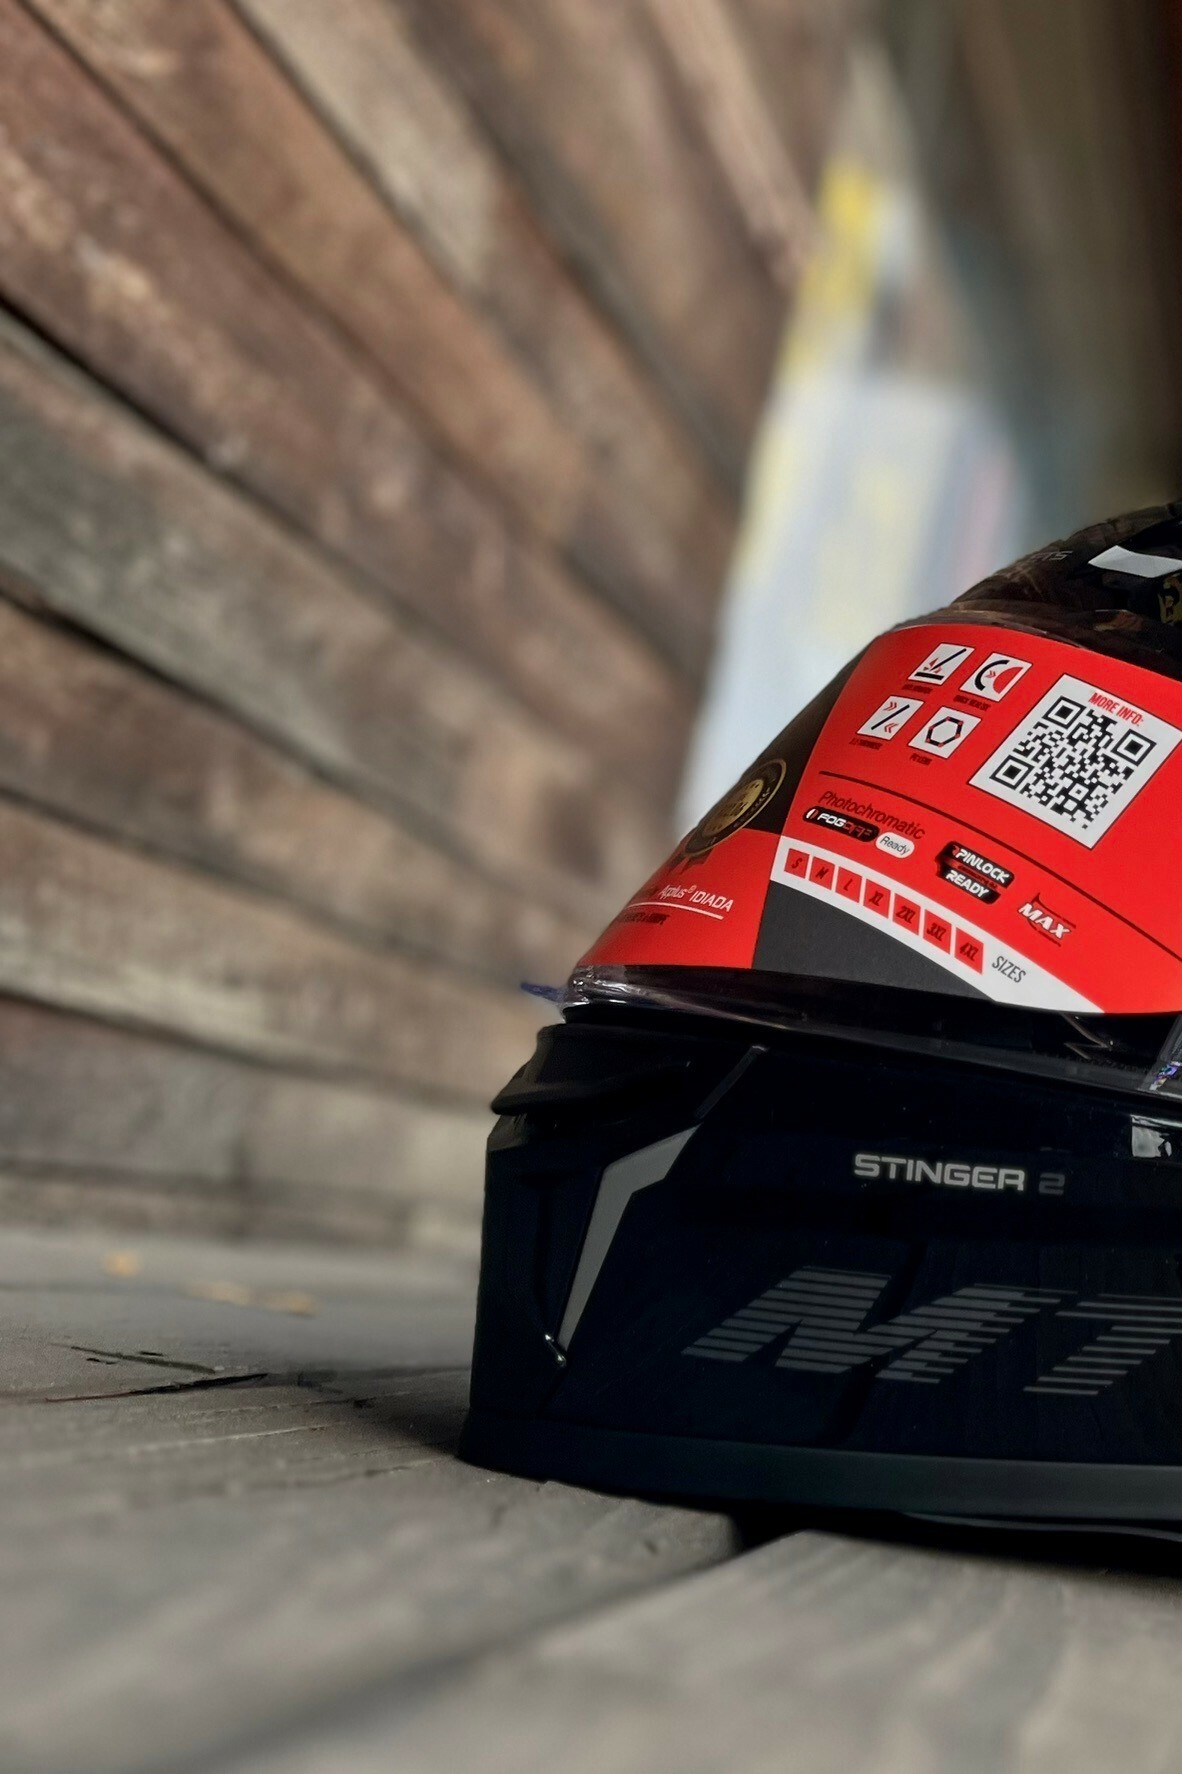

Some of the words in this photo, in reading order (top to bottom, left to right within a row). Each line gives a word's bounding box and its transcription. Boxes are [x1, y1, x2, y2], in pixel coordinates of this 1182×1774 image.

[1088, 692, 1119, 714] MORE
[1116, 706, 1143, 727] INFO:
[817, 790, 925, 840] Photochromatic
[879, 836, 909, 855] Ready
[945, 869, 989, 898] READY
[955, 848, 1010, 884] PINLOCK
[689, 890, 734, 913] IDIADA
[791, 857, 803, 869] S
[815, 866, 829, 880] M
[843, 878, 853, 892] L
[896, 905, 916, 924] 2XL
[926, 922, 947, 942] 3XL
[959, 942, 979, 962] 4XL
[991, 955, 1027, 984] SIZES
[1017, 902, 1072, 939] MAX
[854, 1153, 1026, 1191] STINGER
[1038, 1172, 1066, 1196] 2
